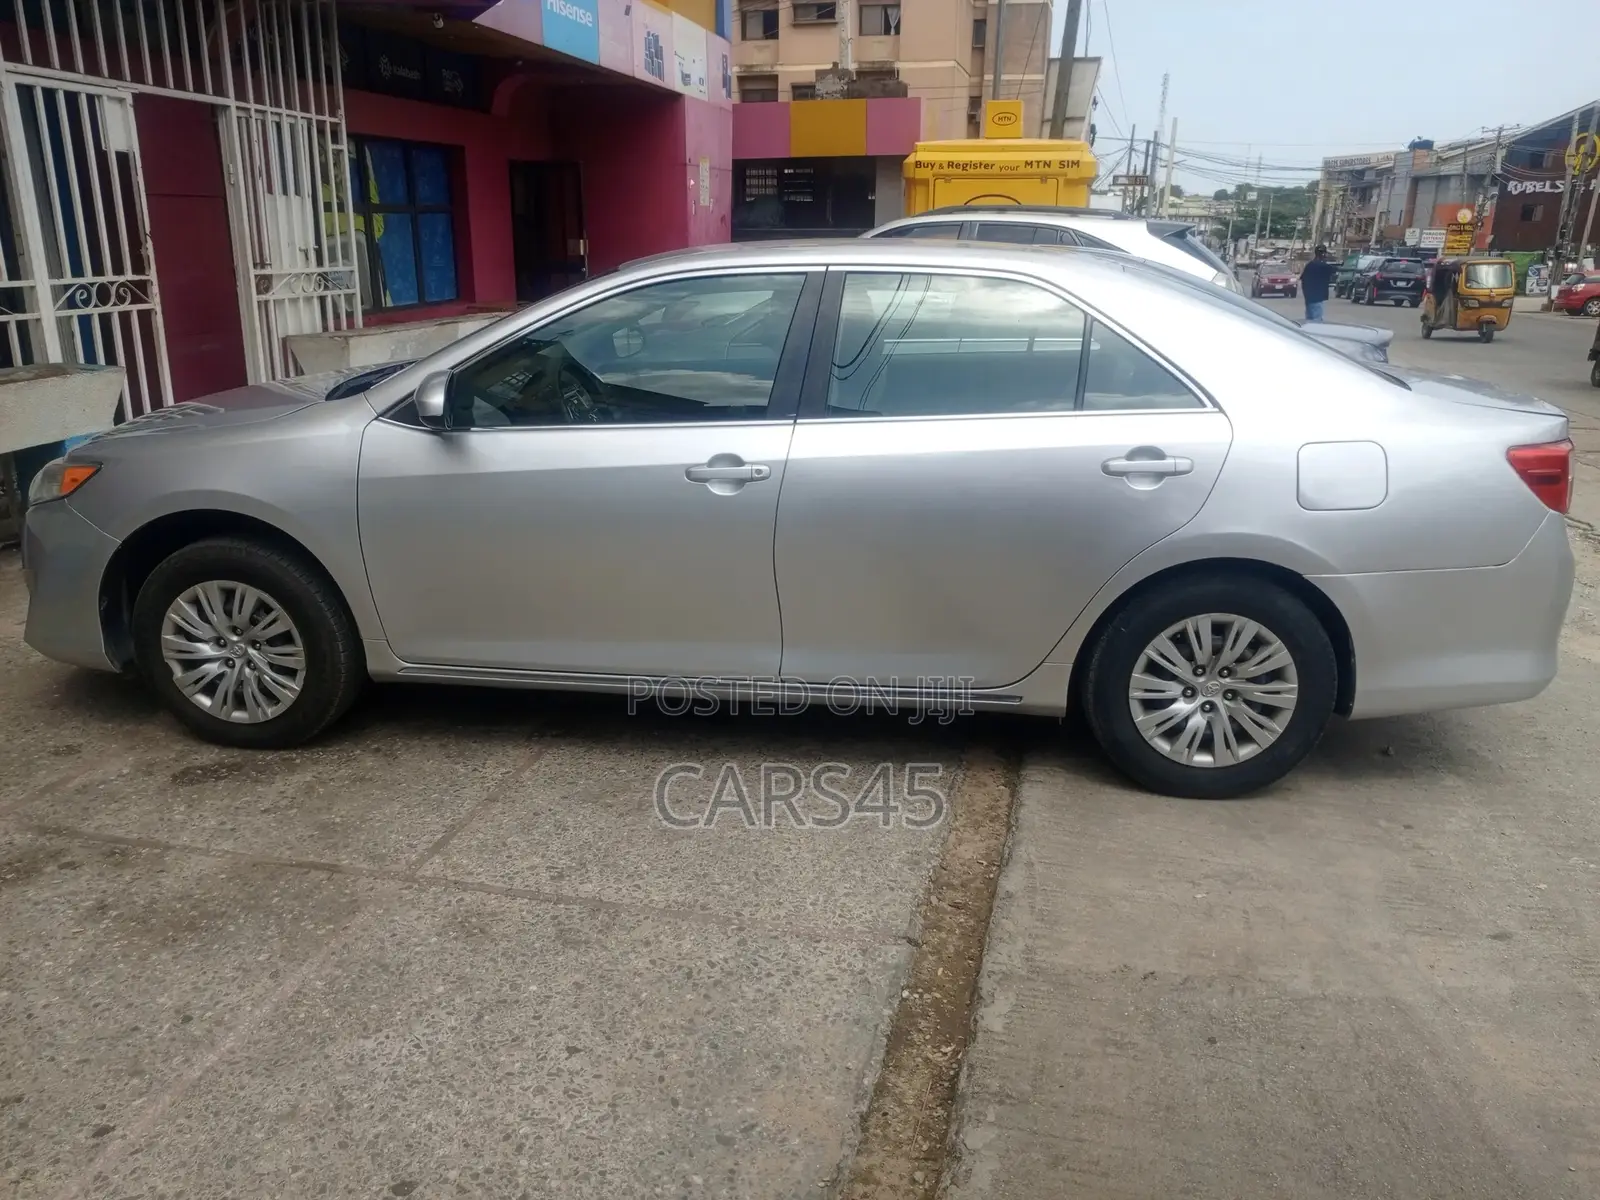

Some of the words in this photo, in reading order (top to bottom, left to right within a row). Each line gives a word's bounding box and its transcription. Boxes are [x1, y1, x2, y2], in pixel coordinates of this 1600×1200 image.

[915, 160, 936, 171] Buy
[947, 160, 996, 172] Register
[999, 163, 1020, 172] your
[1024, 160, 1052, 169] MTN
[1058, 160, 1080, 169] SIM
